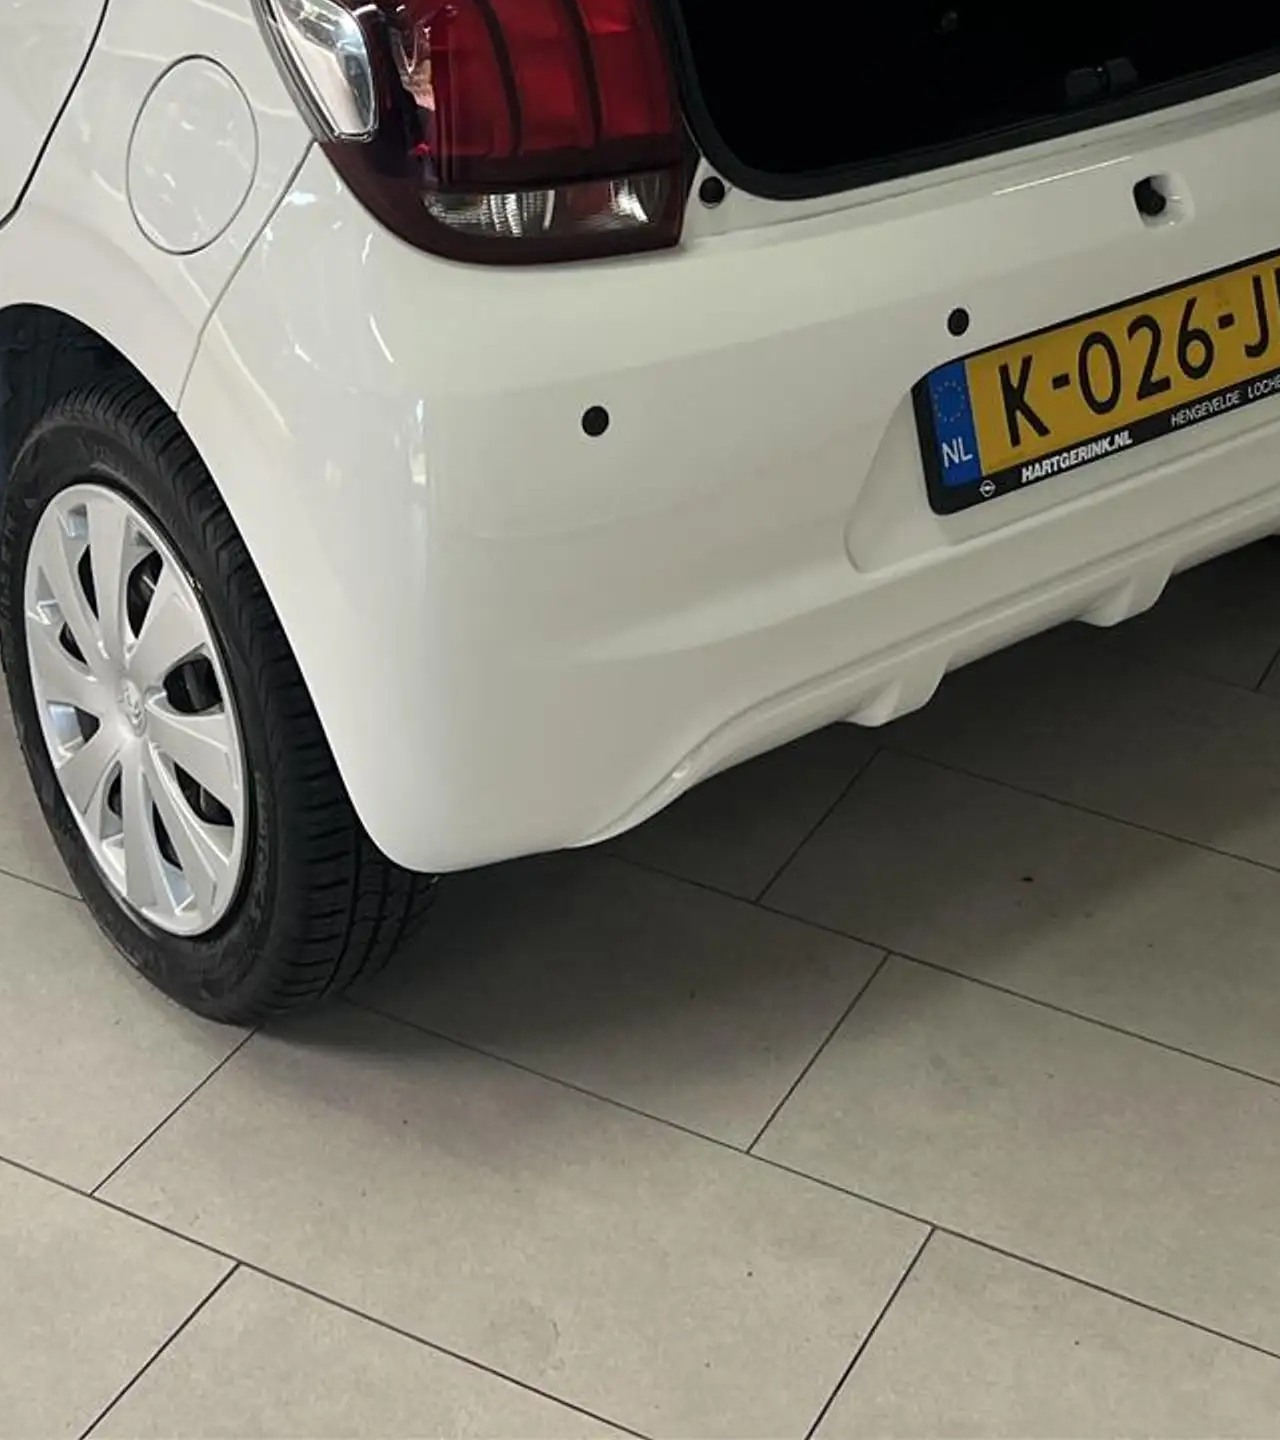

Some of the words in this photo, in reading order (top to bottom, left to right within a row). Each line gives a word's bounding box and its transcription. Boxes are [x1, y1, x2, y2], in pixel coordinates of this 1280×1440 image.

[941, 439, 973, 468] NL
[1021, 430, 1133, 484] HARTGERINK.NL
[1170, 389, 1241, 427] HENGEVELDE
